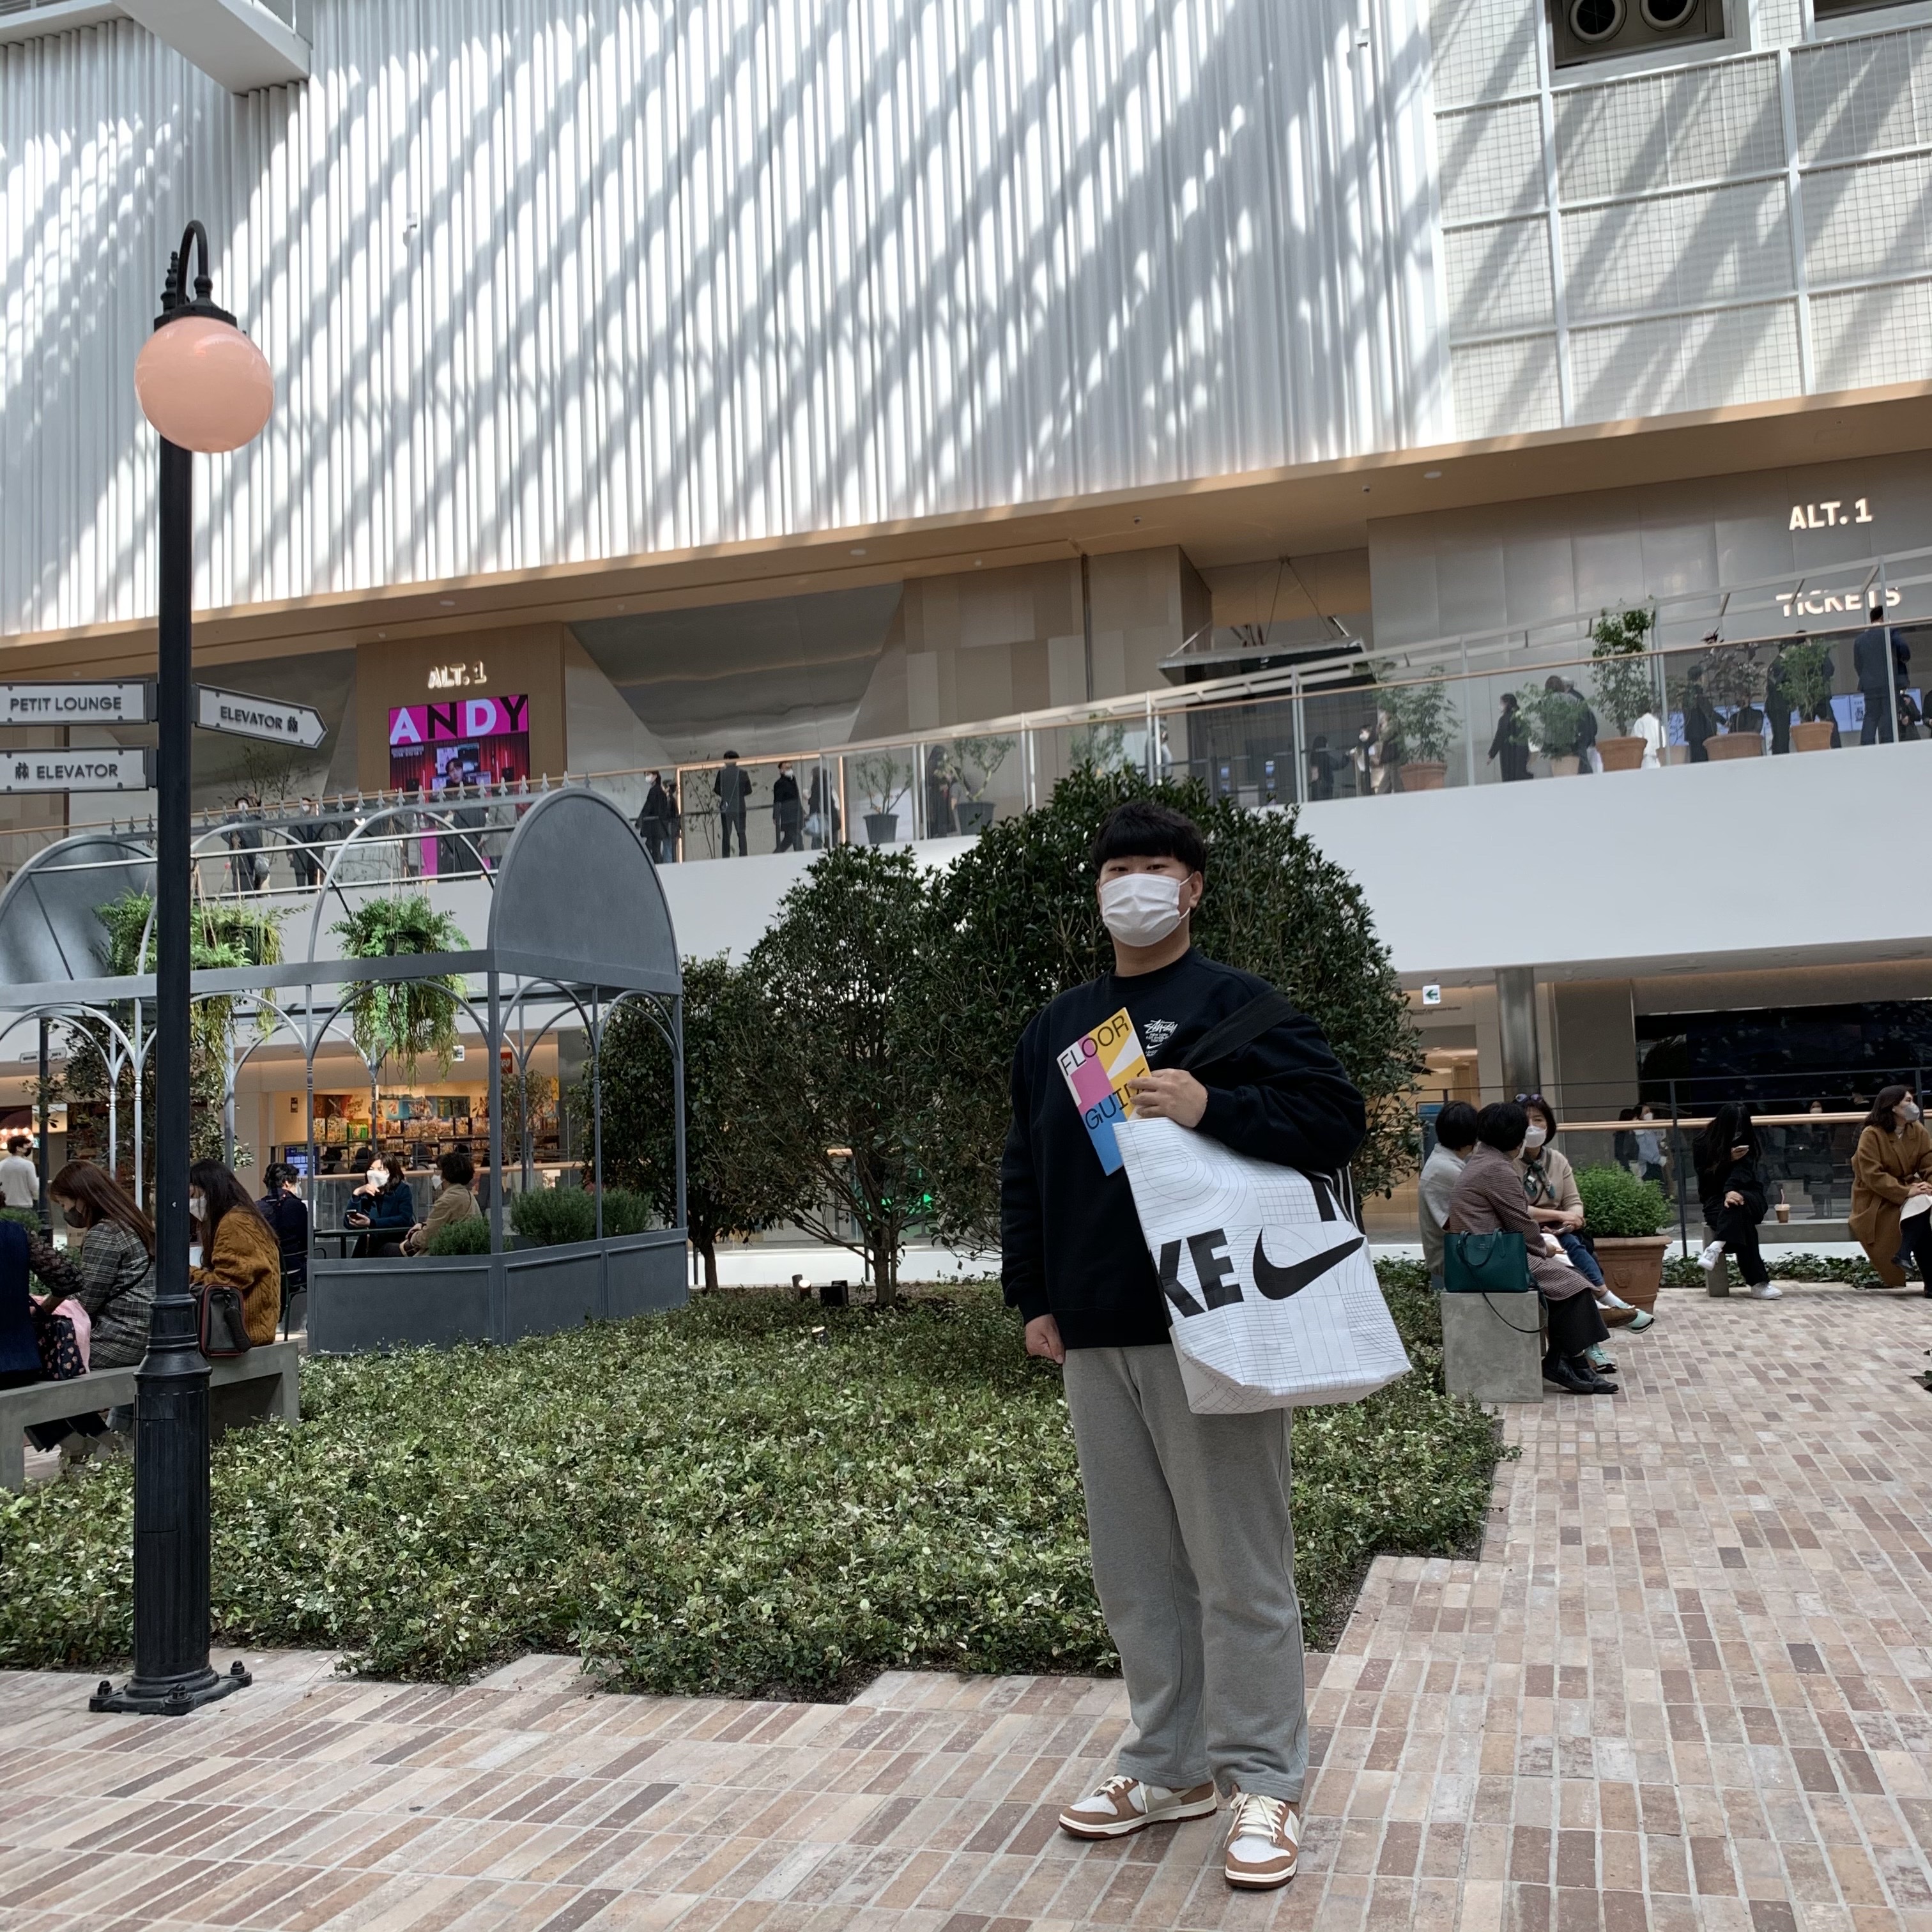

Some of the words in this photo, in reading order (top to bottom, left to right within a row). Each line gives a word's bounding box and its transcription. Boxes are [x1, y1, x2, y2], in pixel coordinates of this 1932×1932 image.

[1789, 501, 1849, 531] ALT.
[1855, 498, 1873, 523] 1
[427, 663, 470, 689] ALT.
[474, 661, 487, 684] 1
[10, 697, 52, 712] PETIT
[55, 696, 121, 711] LOUNGE
[220, 705, 282, 730] ELEVATOR
[390, 694, 528, 746] ANDY
[36, 763, 118, 779] ELEVATOR
[1060, 1015, 1130, 1077] FLOOR
[1085, 1068, 1146, 1130] GUID
[1149, 1228, 1245, 1327] KE
